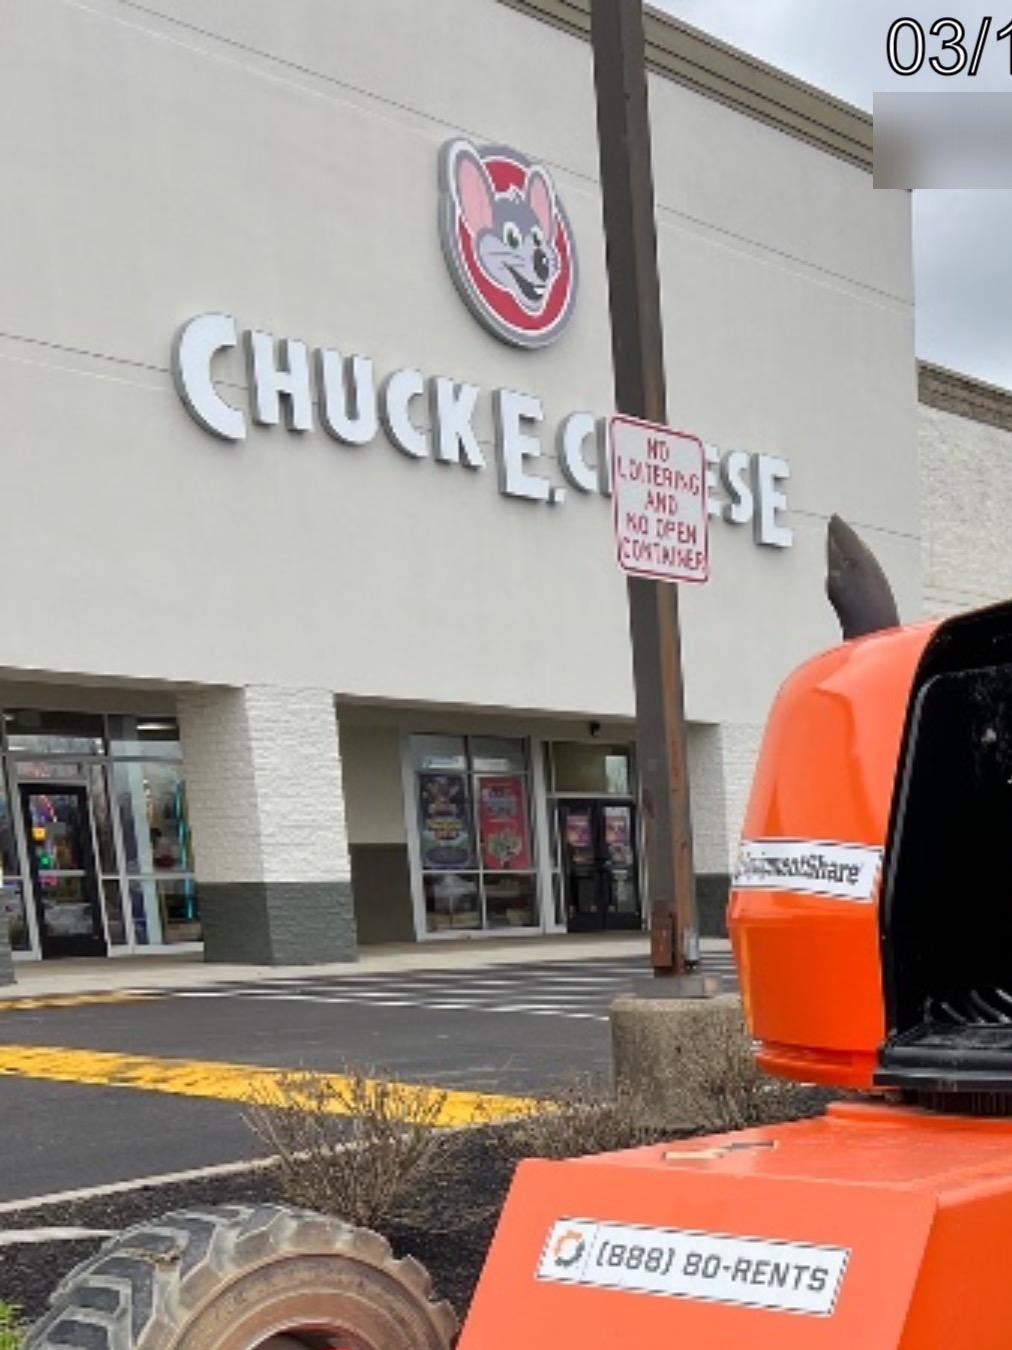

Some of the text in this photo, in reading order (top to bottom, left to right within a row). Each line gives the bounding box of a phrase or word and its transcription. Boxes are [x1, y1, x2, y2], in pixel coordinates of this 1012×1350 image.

[173, 311, 793, 549] CHUCK E. CESE
[647, 437, 670, 462] NO
[617, 455, 700, 496] LOITERING
[645, 490, 678, 515] AND
[626, 511, 697, 545] NO OPEN
[595, 1241, 830, 1293] (888) 80-RENTS
